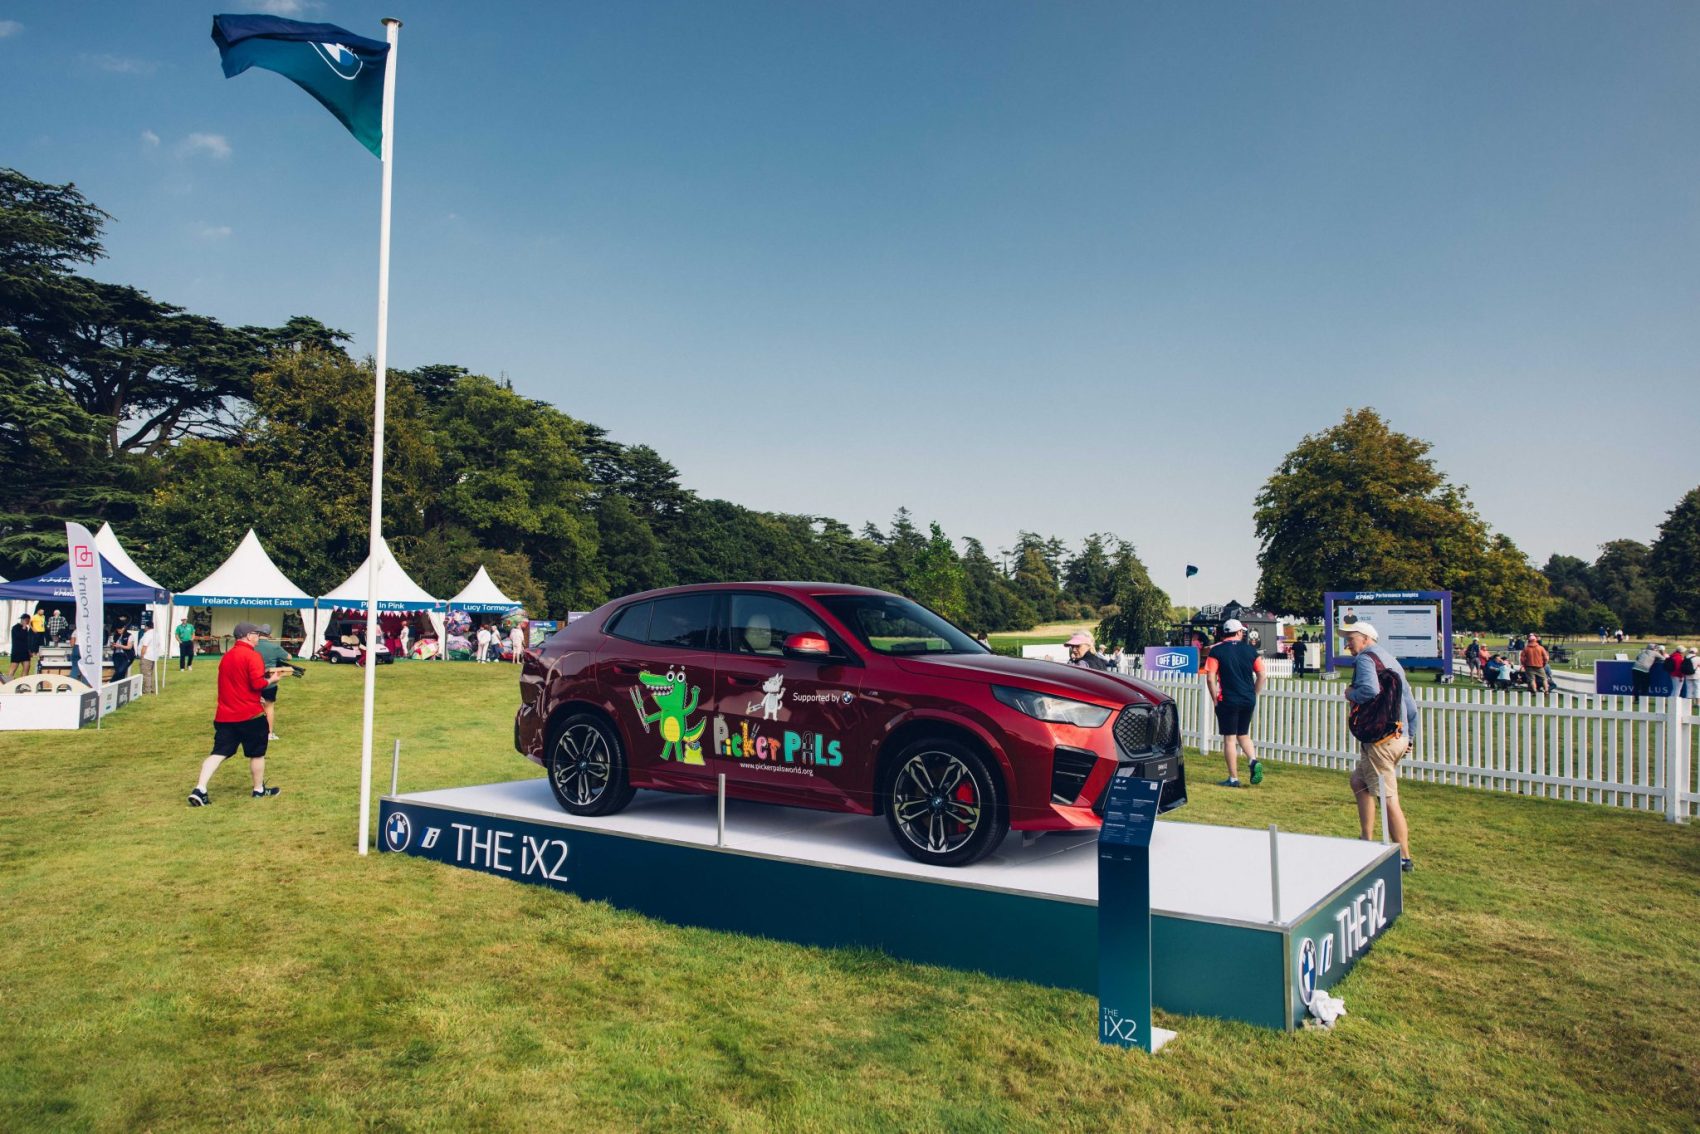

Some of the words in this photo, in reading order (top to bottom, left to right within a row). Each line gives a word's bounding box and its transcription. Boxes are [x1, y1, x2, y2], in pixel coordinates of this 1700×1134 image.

[202, 597, 238, 605] Ireland's
[240, 598, 272, 606] Ancient
[1159, 656, 1171, 665] OFF
[793, 692, 830, 702] Supported
[831, 694, 840, 704] by
[451, 823, 514, 872] THE
[521, 835, 568, 882] iX2
[1336, 893, 1368, 964] THE
[1103, 1007, 1118, 1017] THE
[1104, 1015, 1137, 1042] iX2
